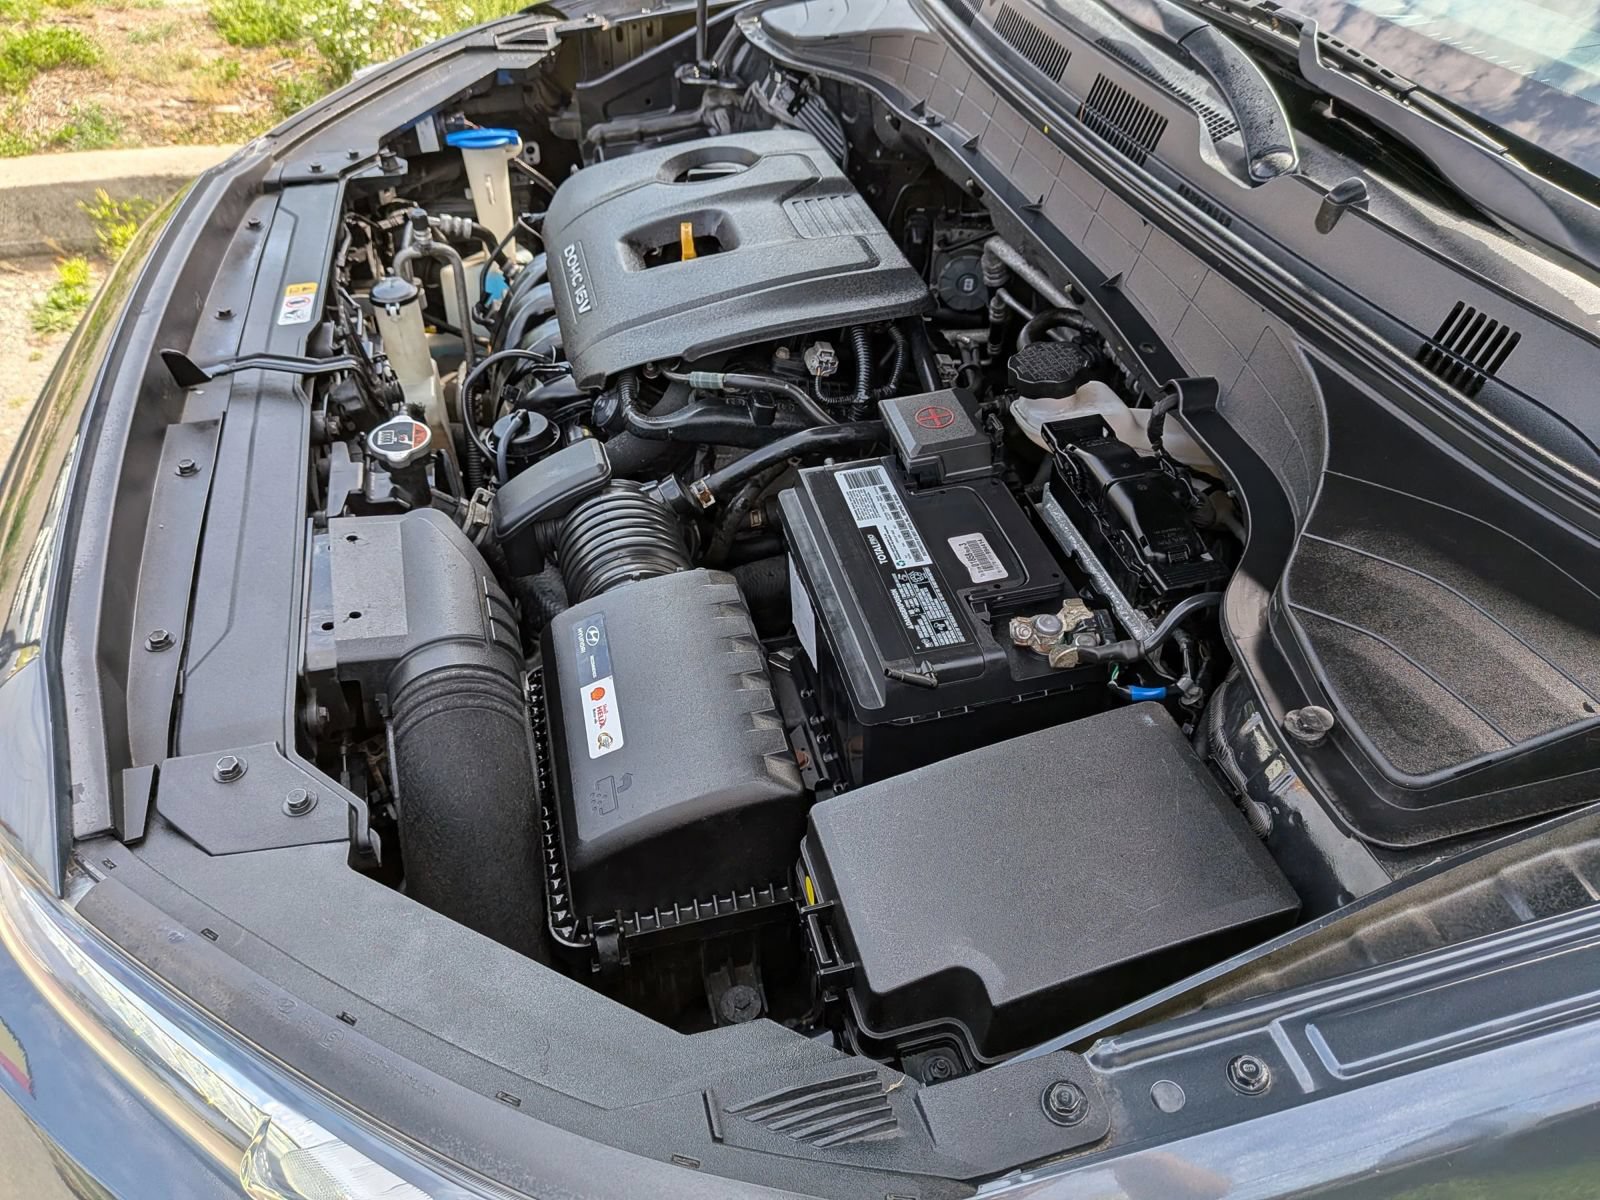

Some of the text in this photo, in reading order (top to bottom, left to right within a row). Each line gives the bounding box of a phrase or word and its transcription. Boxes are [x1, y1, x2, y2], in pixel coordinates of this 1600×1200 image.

[564, 244, 591, 314] DOHC 16V
[867, 534, 889, 565] TOTALPRO
[577, 627, 586, 653] HYUNDAI
